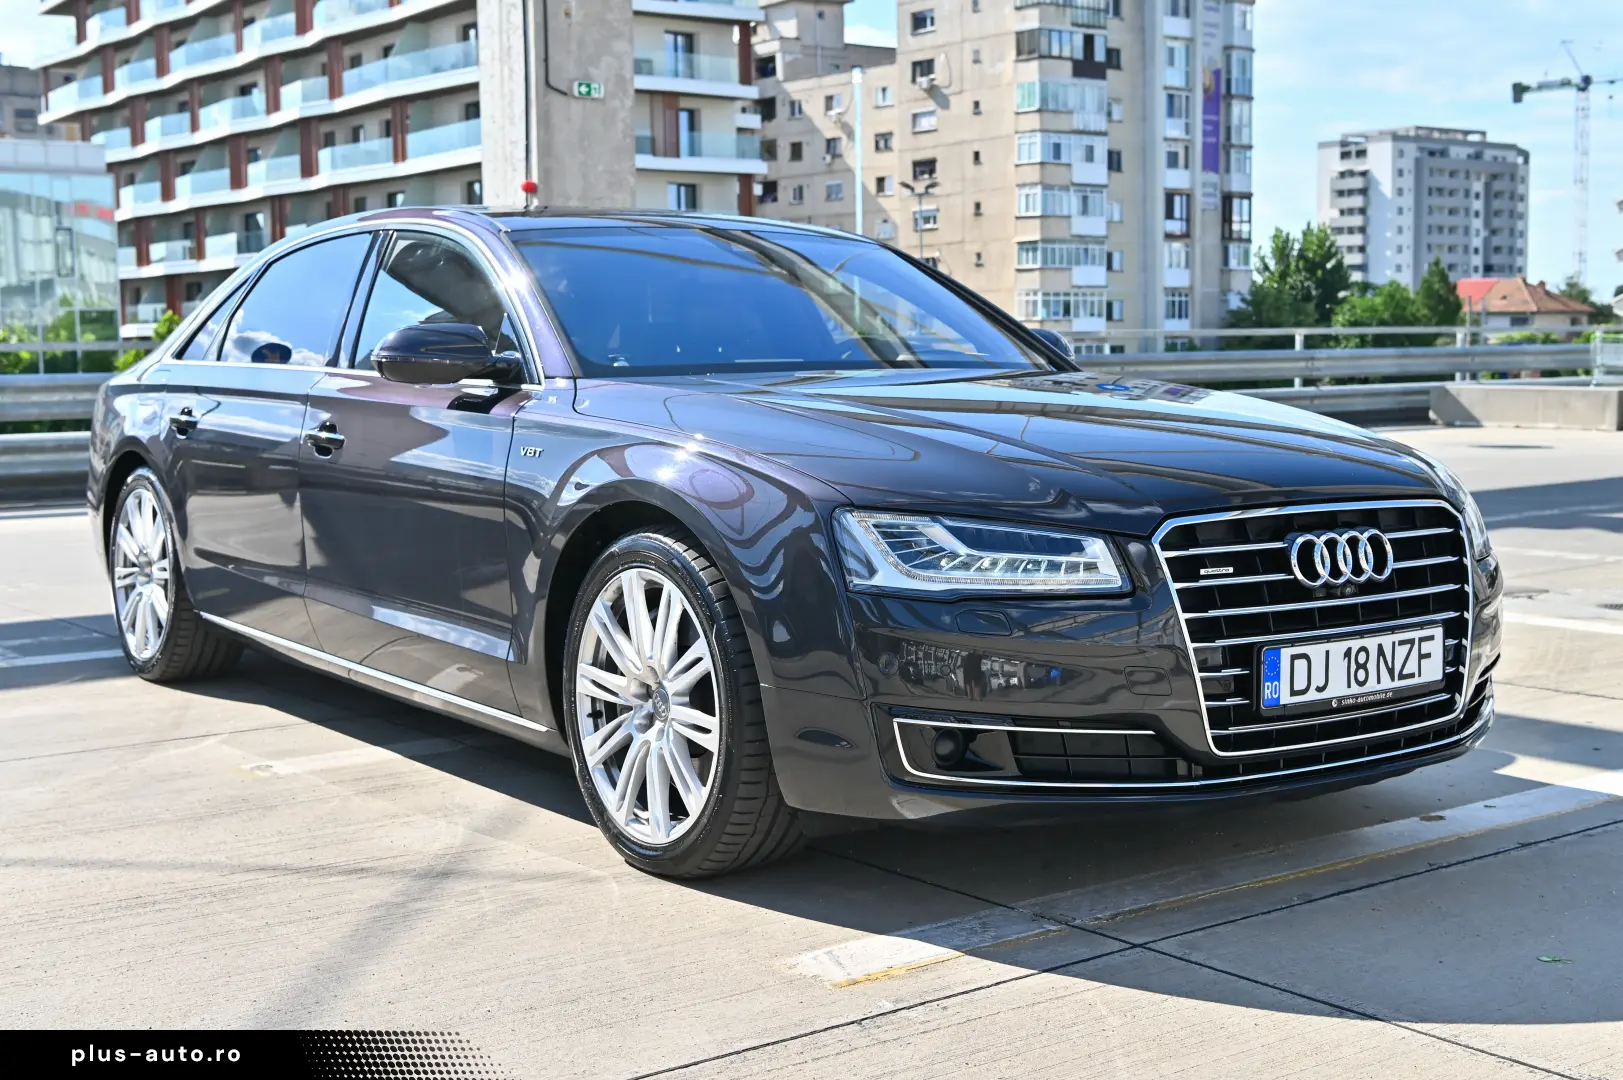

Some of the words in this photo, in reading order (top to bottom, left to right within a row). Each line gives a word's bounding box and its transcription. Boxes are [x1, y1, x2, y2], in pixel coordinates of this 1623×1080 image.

[520, 446, 544, 458] V8T
[1289, 650, 1330, 697] DJ
[1264, 681, 1279, 699] RO
